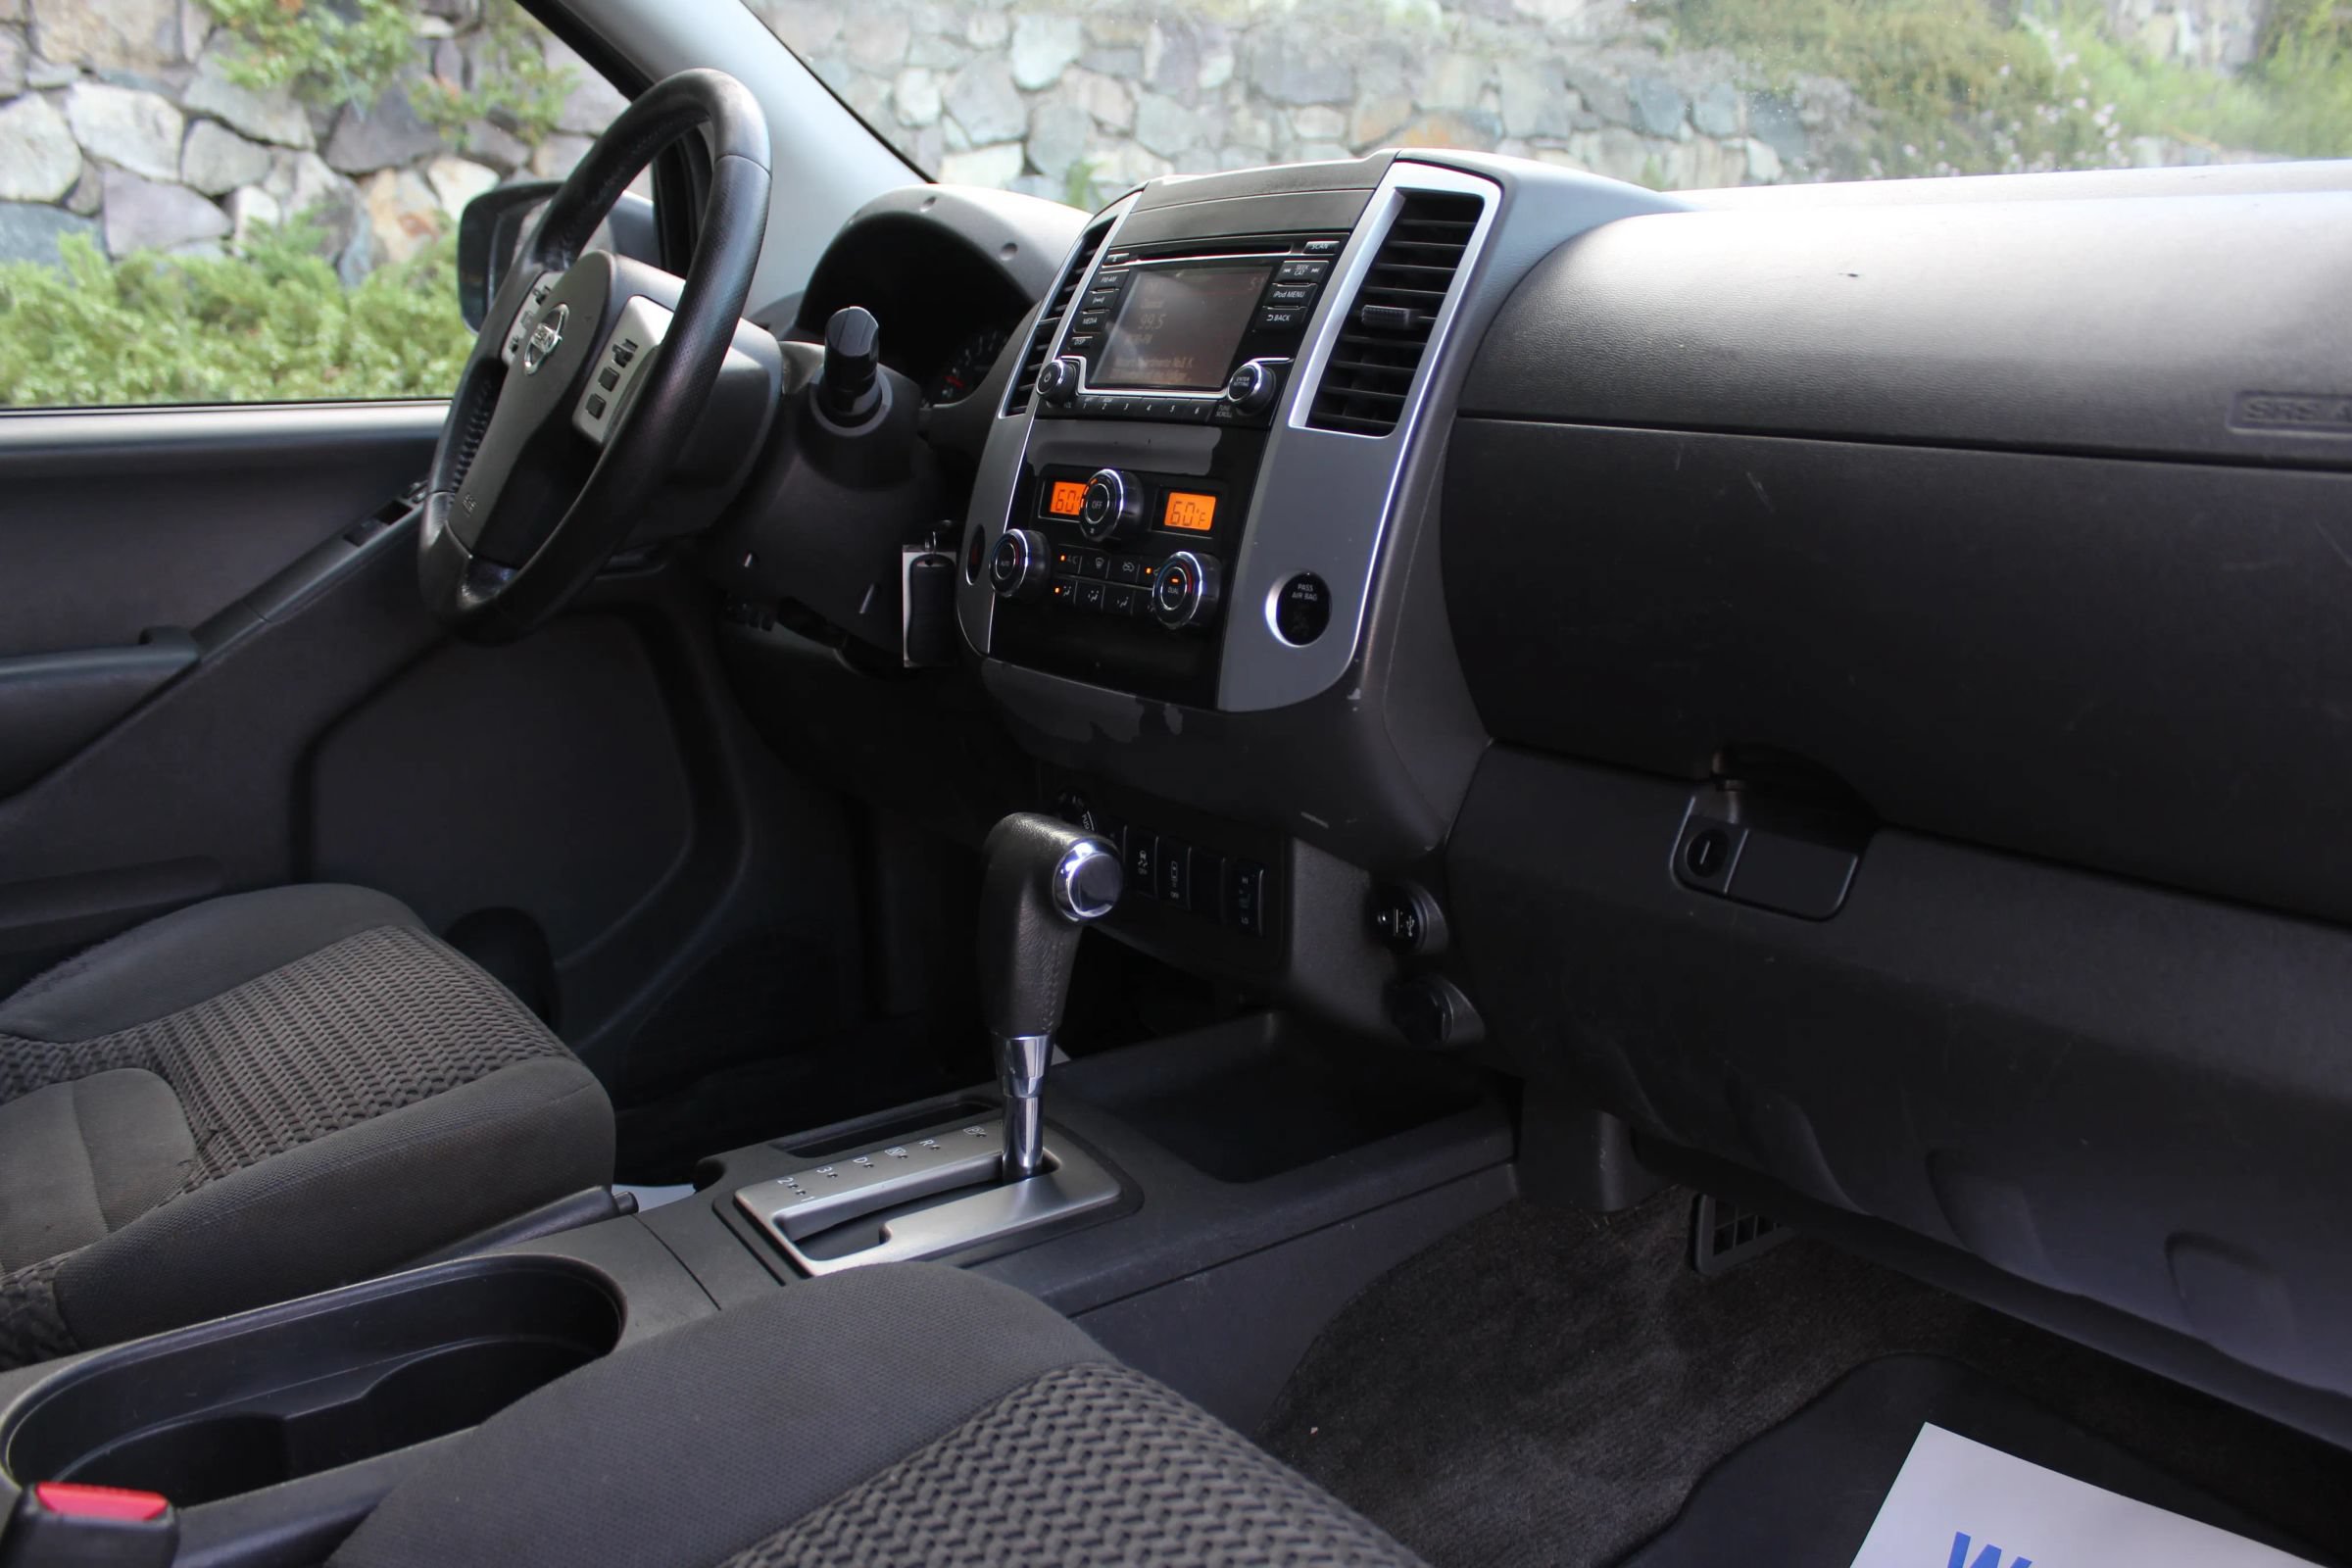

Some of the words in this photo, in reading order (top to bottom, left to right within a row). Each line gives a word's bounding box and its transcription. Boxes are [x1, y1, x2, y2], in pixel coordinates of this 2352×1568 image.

[1082, 317, 1098, 325] MEDIA
[1091, 500, 1103, 510] OFF
[1298, 583, 1313, 592] PASS
